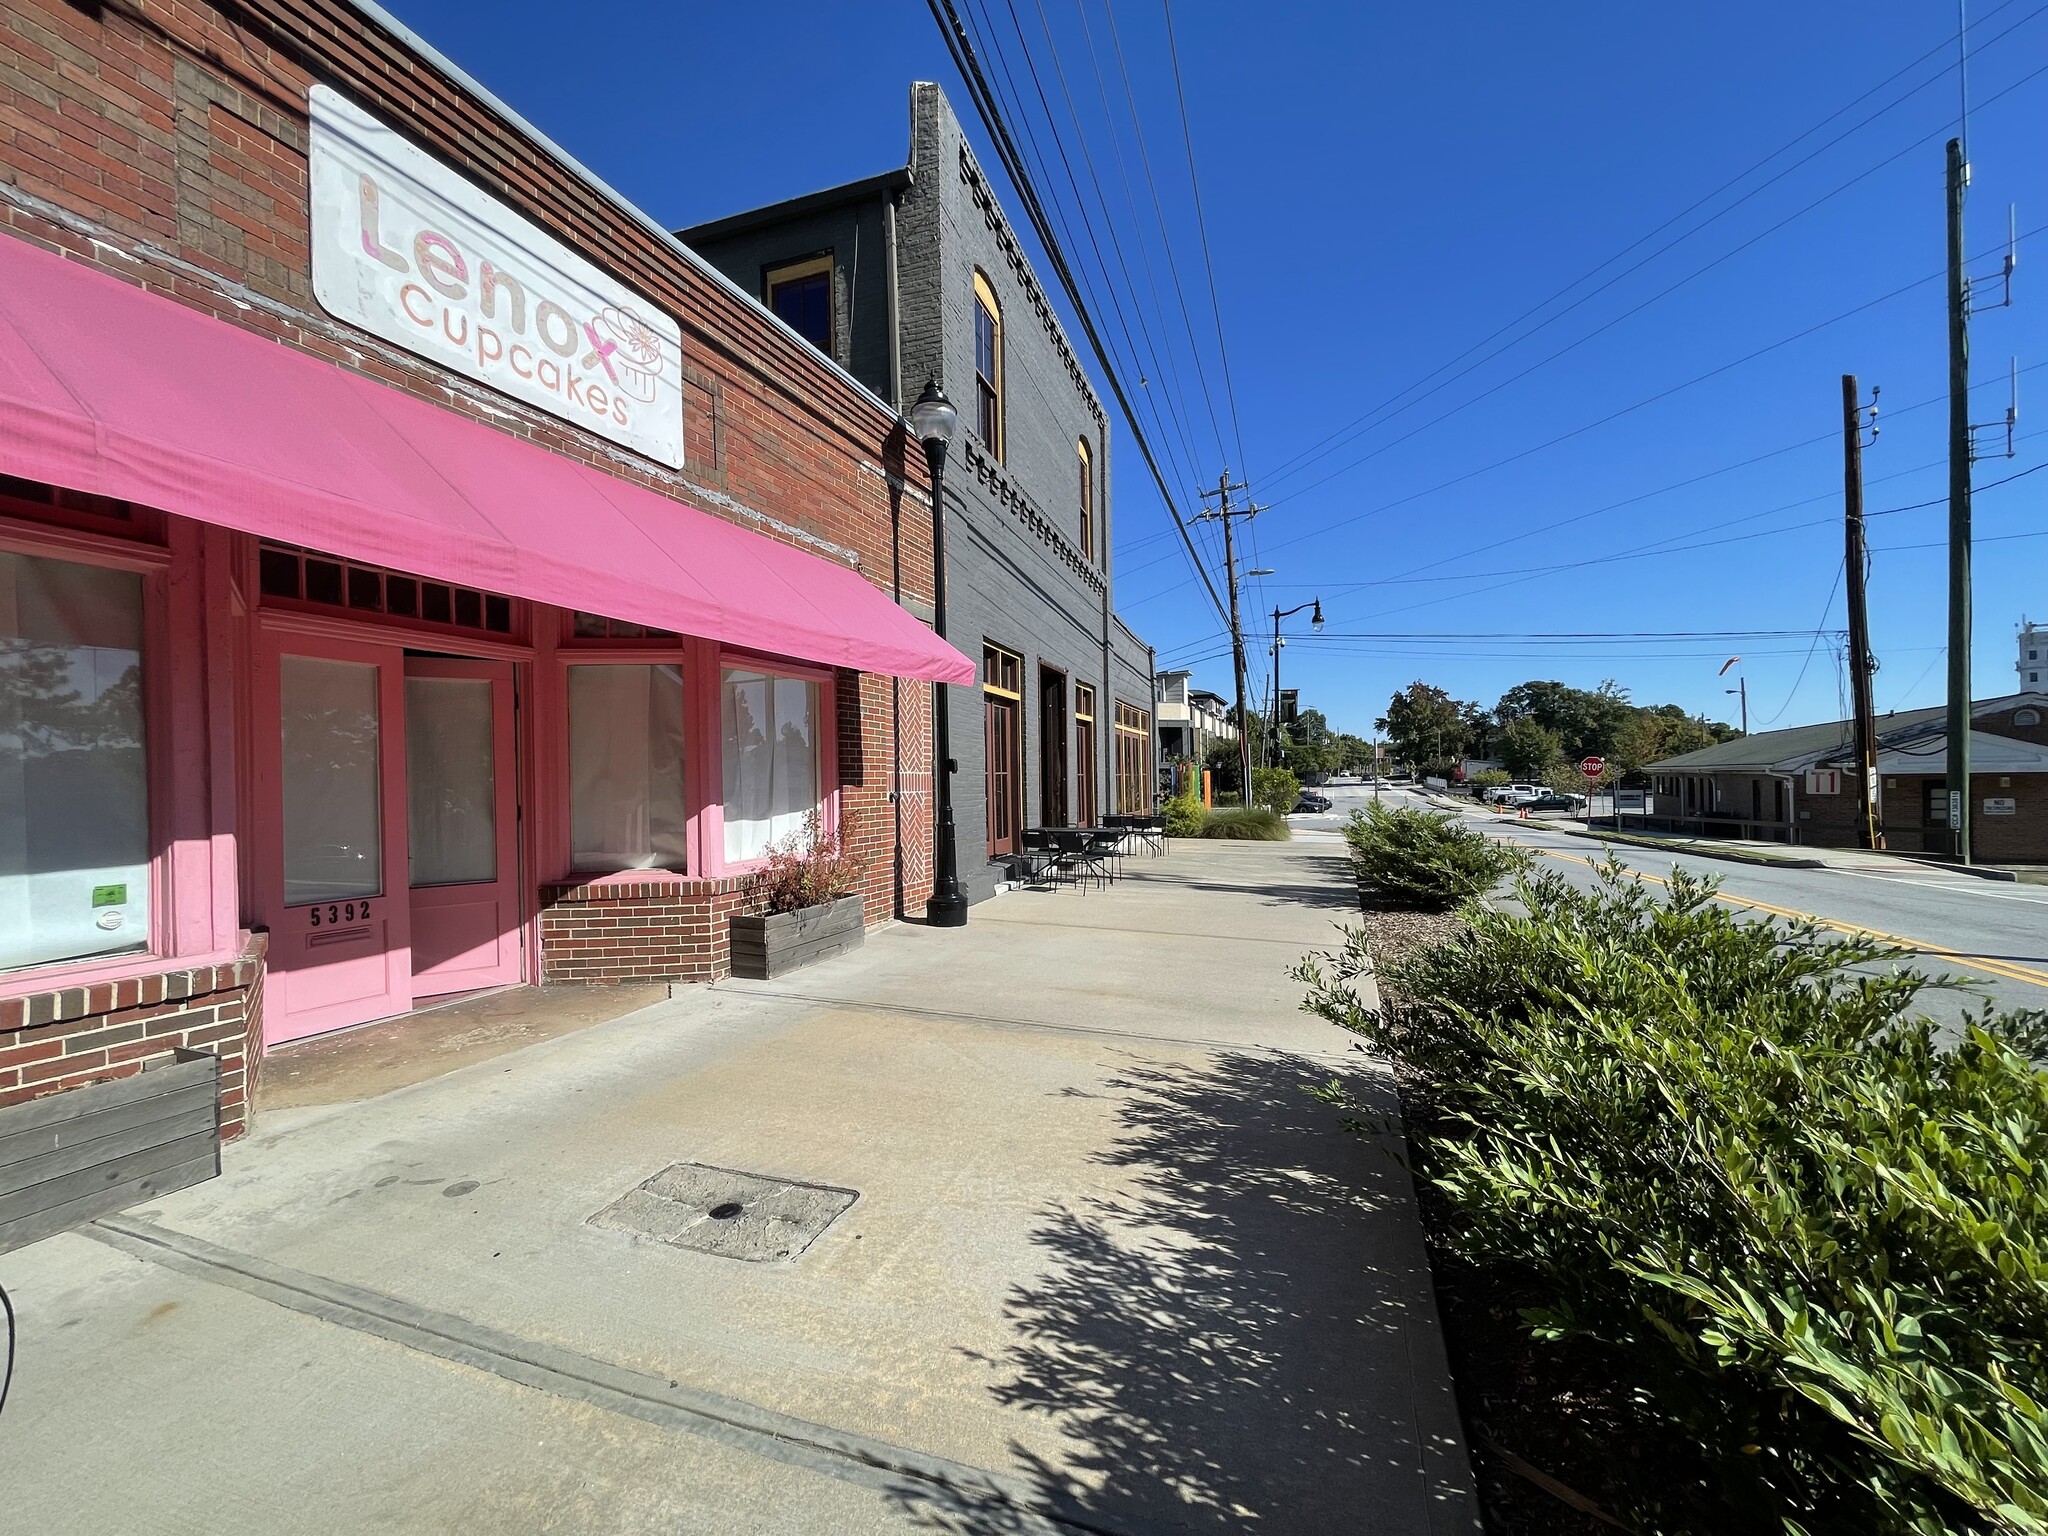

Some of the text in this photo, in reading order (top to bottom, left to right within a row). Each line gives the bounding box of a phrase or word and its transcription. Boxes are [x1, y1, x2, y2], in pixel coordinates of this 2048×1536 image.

[359, 173, 619, 387] Lenox
[400, 284, 627, 425] Cupcakes
[1582, 762, 1603, 771] STOP
[1811, 772, 1835, 793] T1
[311, 901, 370, 927] 5392
